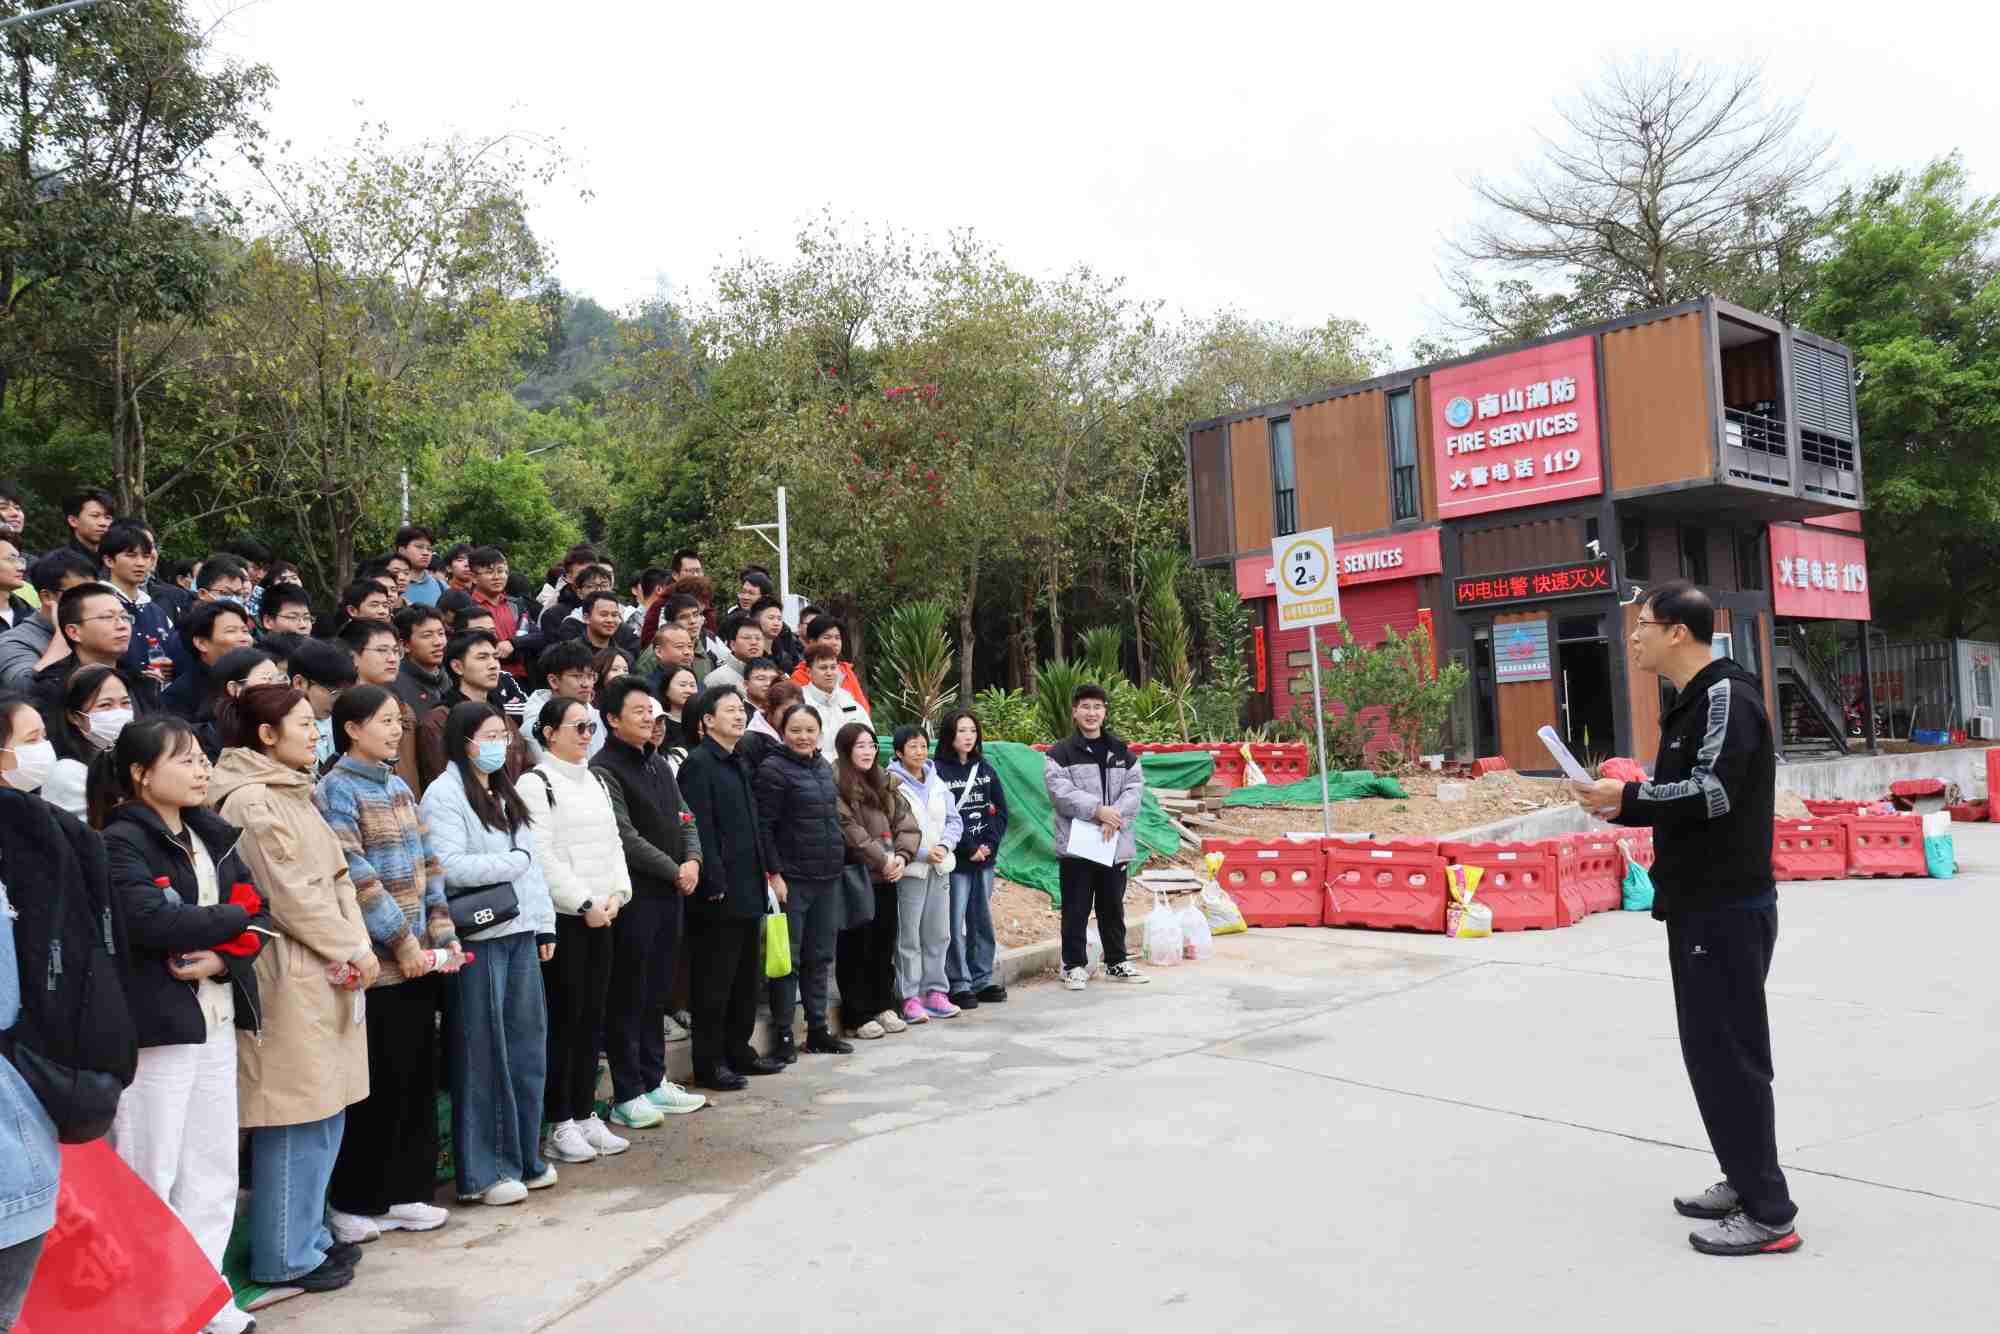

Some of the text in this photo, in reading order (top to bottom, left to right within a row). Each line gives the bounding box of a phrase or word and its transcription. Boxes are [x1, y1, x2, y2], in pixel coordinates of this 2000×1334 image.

[1476, 375, 1576, 421] 南山消防
[1447, 411, 1579, 456] FIRE SERVICES
[1450, 448, 1582, 490] 火警电话 119
[1344, 547, 1404, 573] SERVICES
[1776, 555, 1867, 592] 火警电话 119
[1458, 566, 1609, 602] 闪电出警 快速灭火
